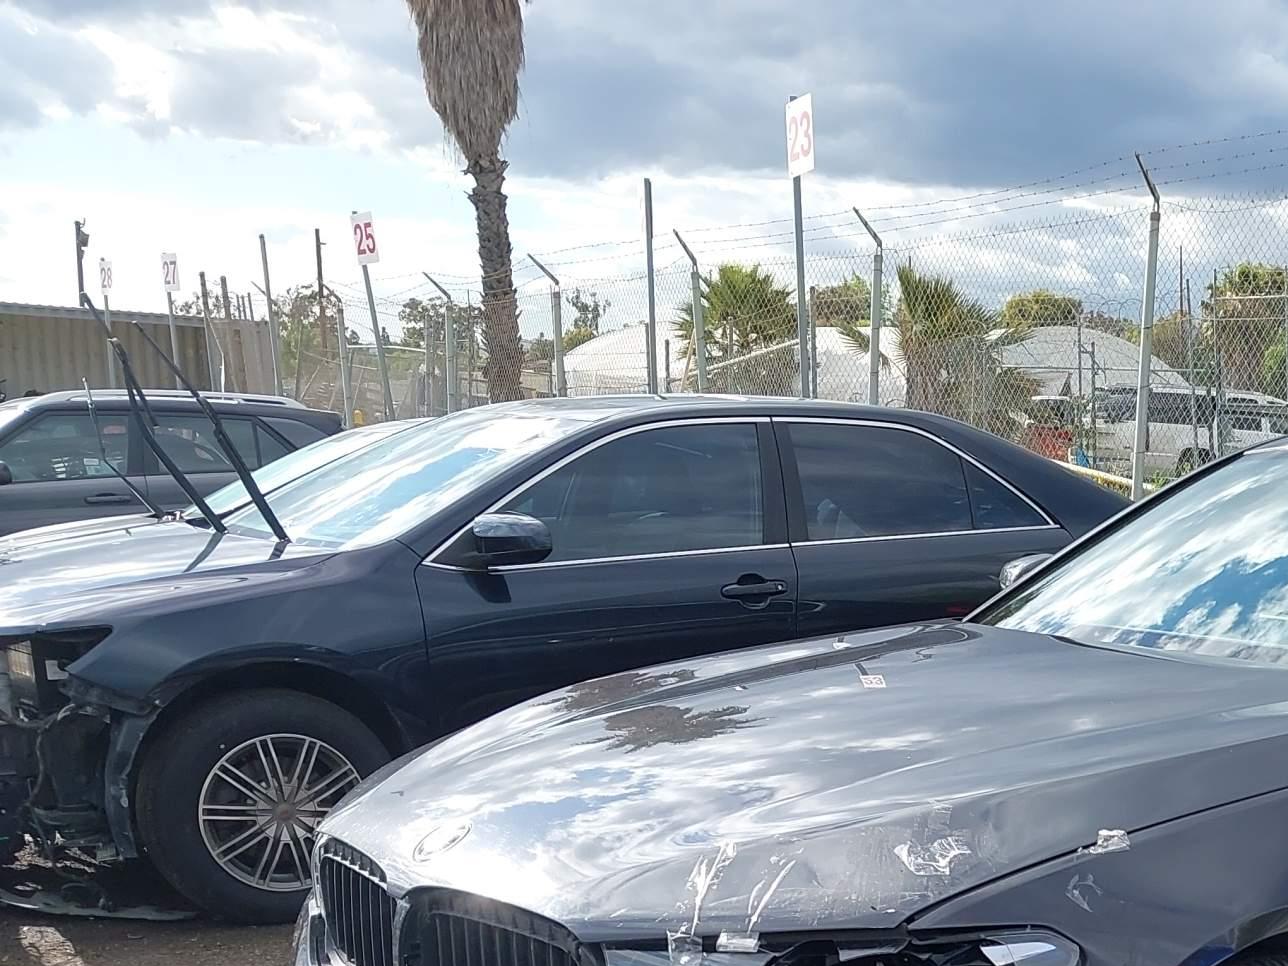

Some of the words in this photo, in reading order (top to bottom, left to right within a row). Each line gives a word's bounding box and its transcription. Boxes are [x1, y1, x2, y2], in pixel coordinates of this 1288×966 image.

[789, 111, 812, 162] 23
[353, 222, 376, 255] 25
[100, 267, 113, 289] 28
[162, 260, 177, 285] 27
